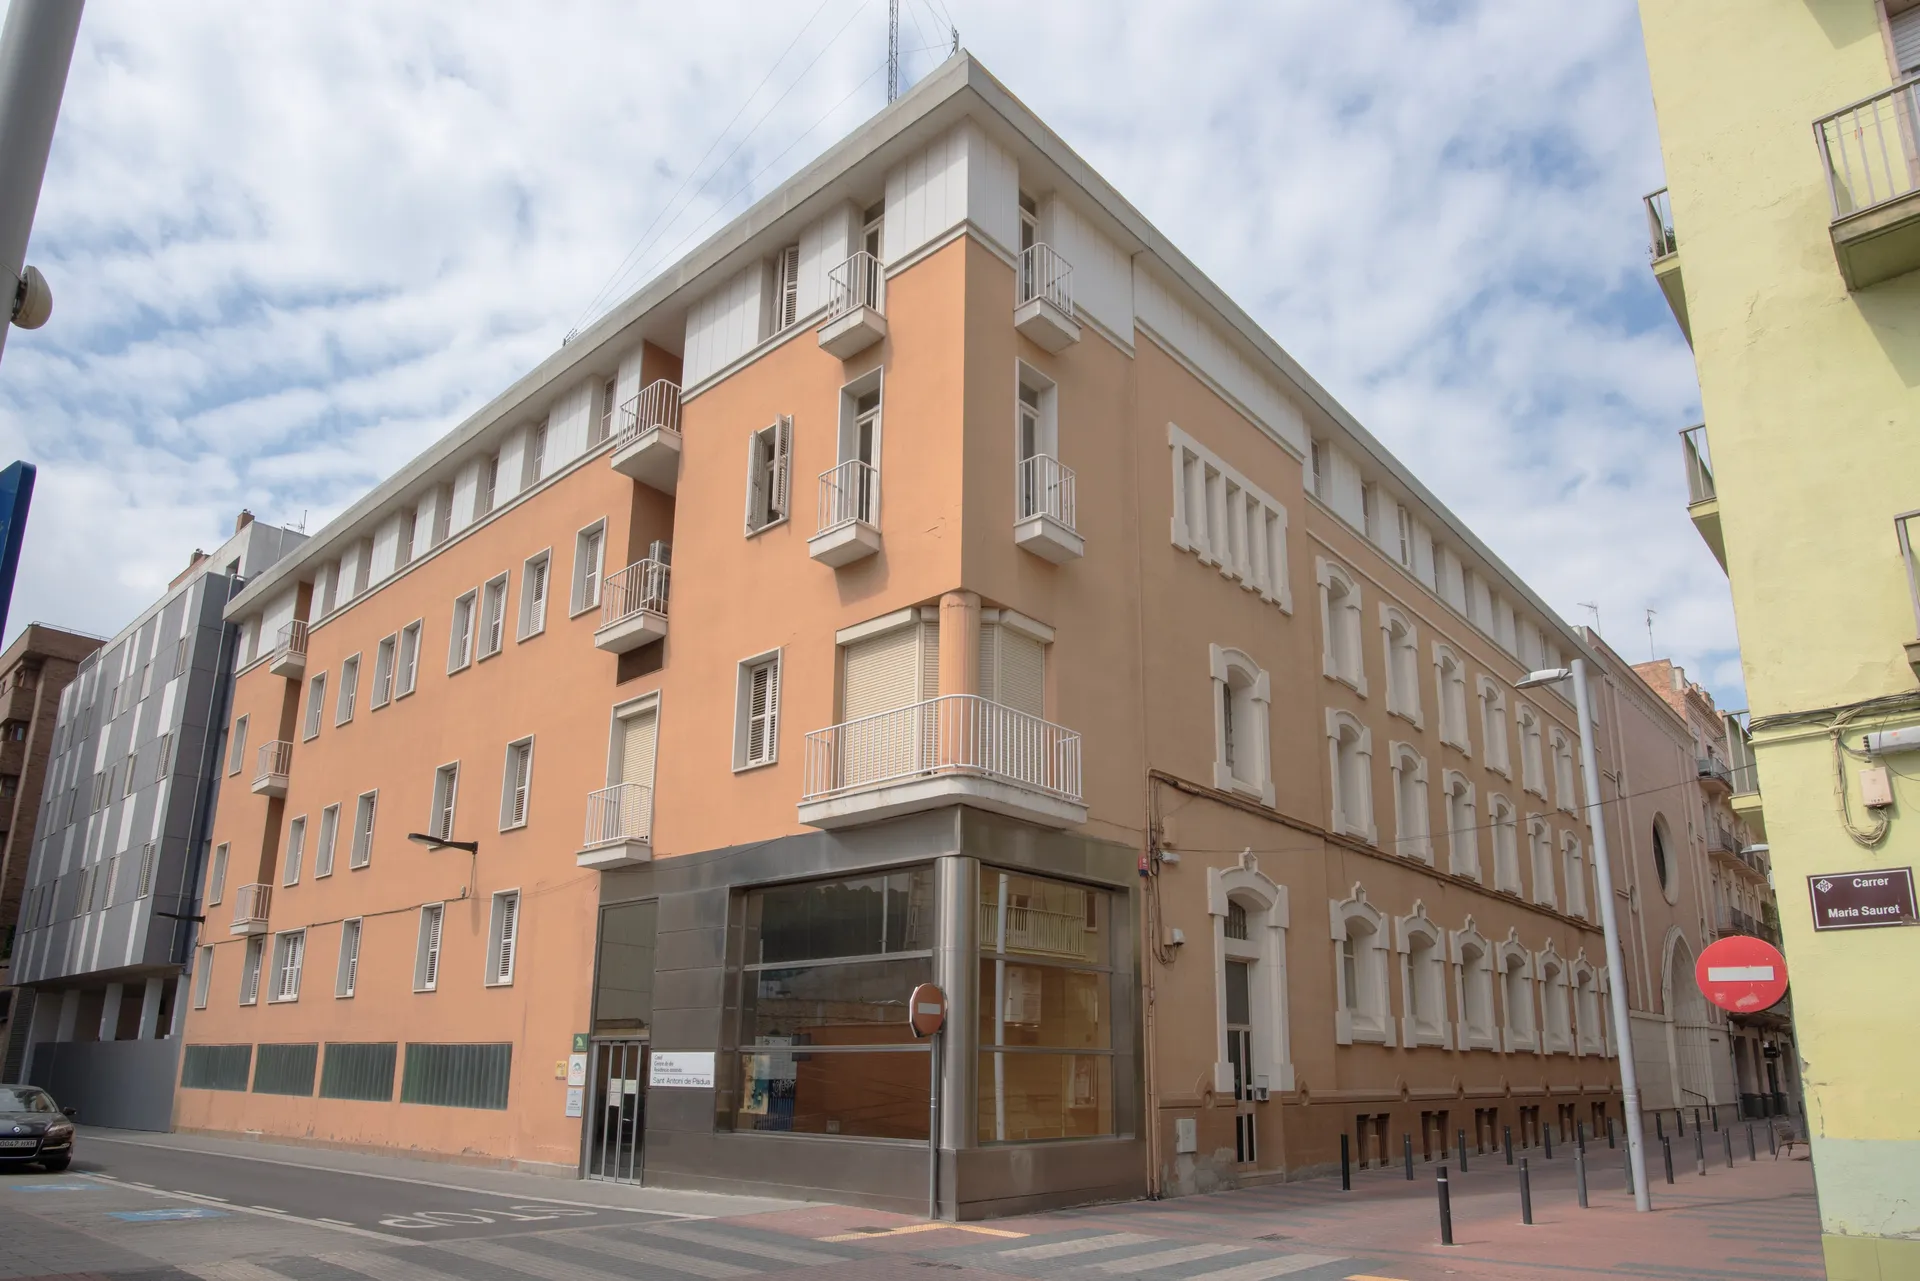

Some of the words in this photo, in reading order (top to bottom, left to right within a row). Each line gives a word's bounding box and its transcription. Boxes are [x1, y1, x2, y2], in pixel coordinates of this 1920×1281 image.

[1852, 877, 1889, 888] Carrer
[1828, 906, 1859, 918] Maria
[1861, 904, 1900, 916] Sauret
[652, 1076, 665, 1084] Sant
[666, 1077, 684, 1085] Antoni
[378, 1205, 598, 1229] STOP
